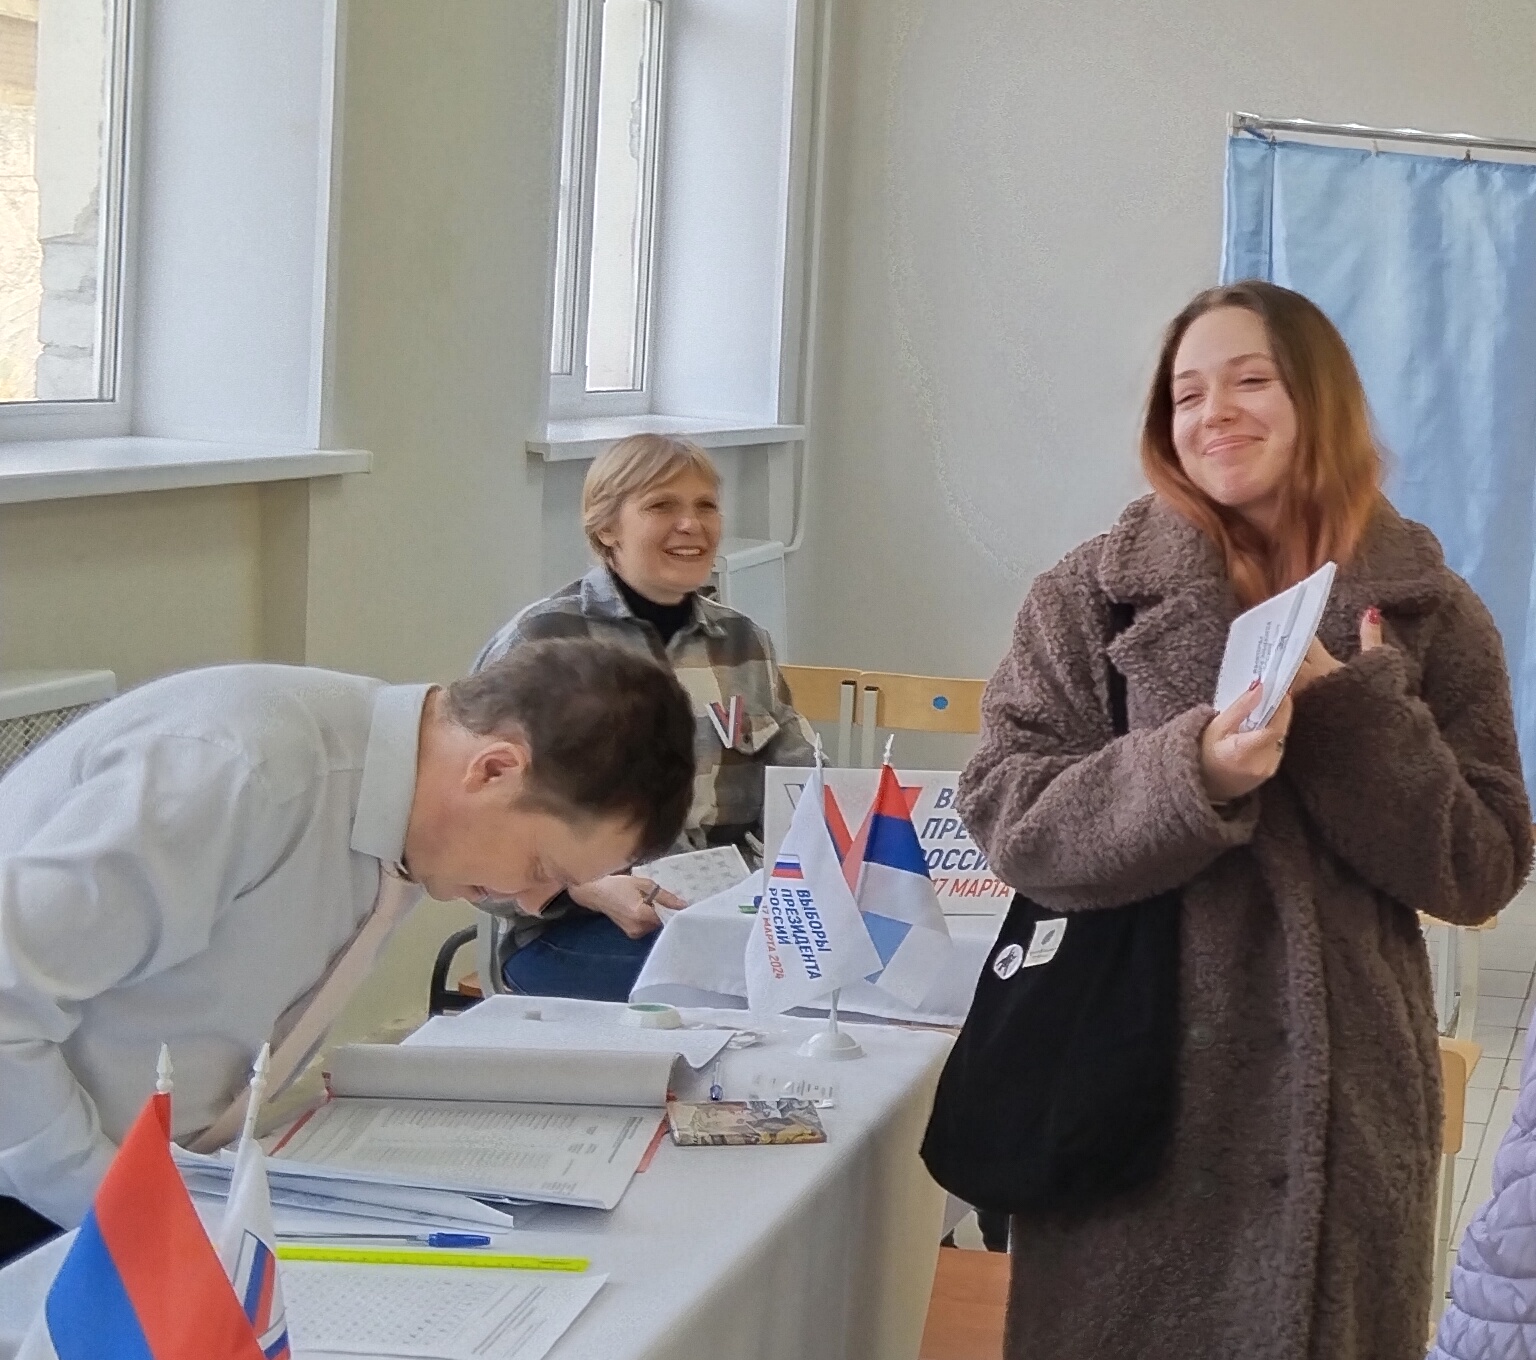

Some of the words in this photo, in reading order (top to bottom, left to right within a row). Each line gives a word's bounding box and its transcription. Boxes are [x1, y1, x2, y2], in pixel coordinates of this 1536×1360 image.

[920, 817, 968, 839] ПРЕ
[923, 848, 988, 871] ОССИ
[948, 878, 1010, 897] МАРТА
[768, 887, 793, 945] РОССИИ
[795, 889, 832, 952] ВЫБОРЫ
[762, 917, 777, 952] МАРТА
[780, 888, 822, 980] ПРЕЗИДЕНТА
